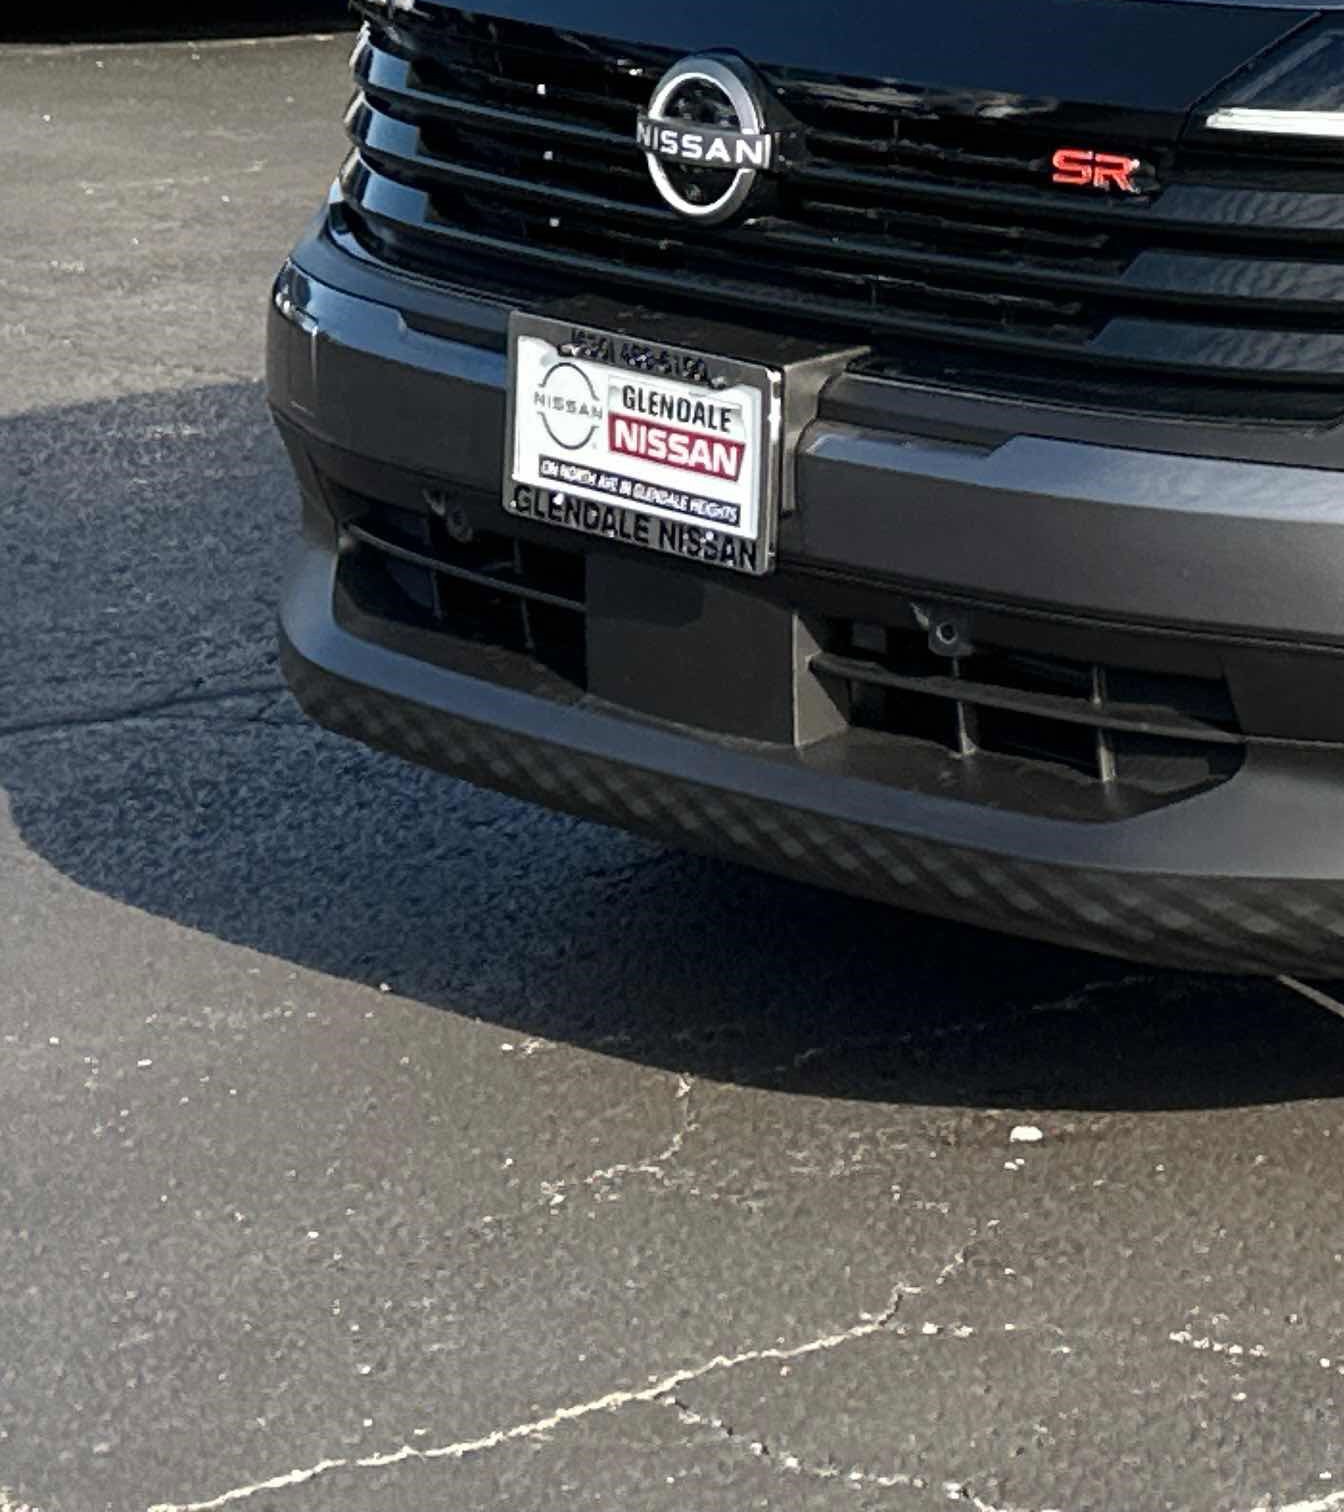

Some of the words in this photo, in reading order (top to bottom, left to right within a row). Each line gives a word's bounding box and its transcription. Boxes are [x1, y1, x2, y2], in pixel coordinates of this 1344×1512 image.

[636, 118, 770, 169] NISSAN
[1052, 148, 1141, 192] SR
[534, 391, 602, 419] NISSAN
[623, 385, 731, 433] GLENDALE
[614, 419, 738, 476] NISSAN
[513, 486, 649, 543] GLENDALE
[659, 520, 757, 571] NISSAN
